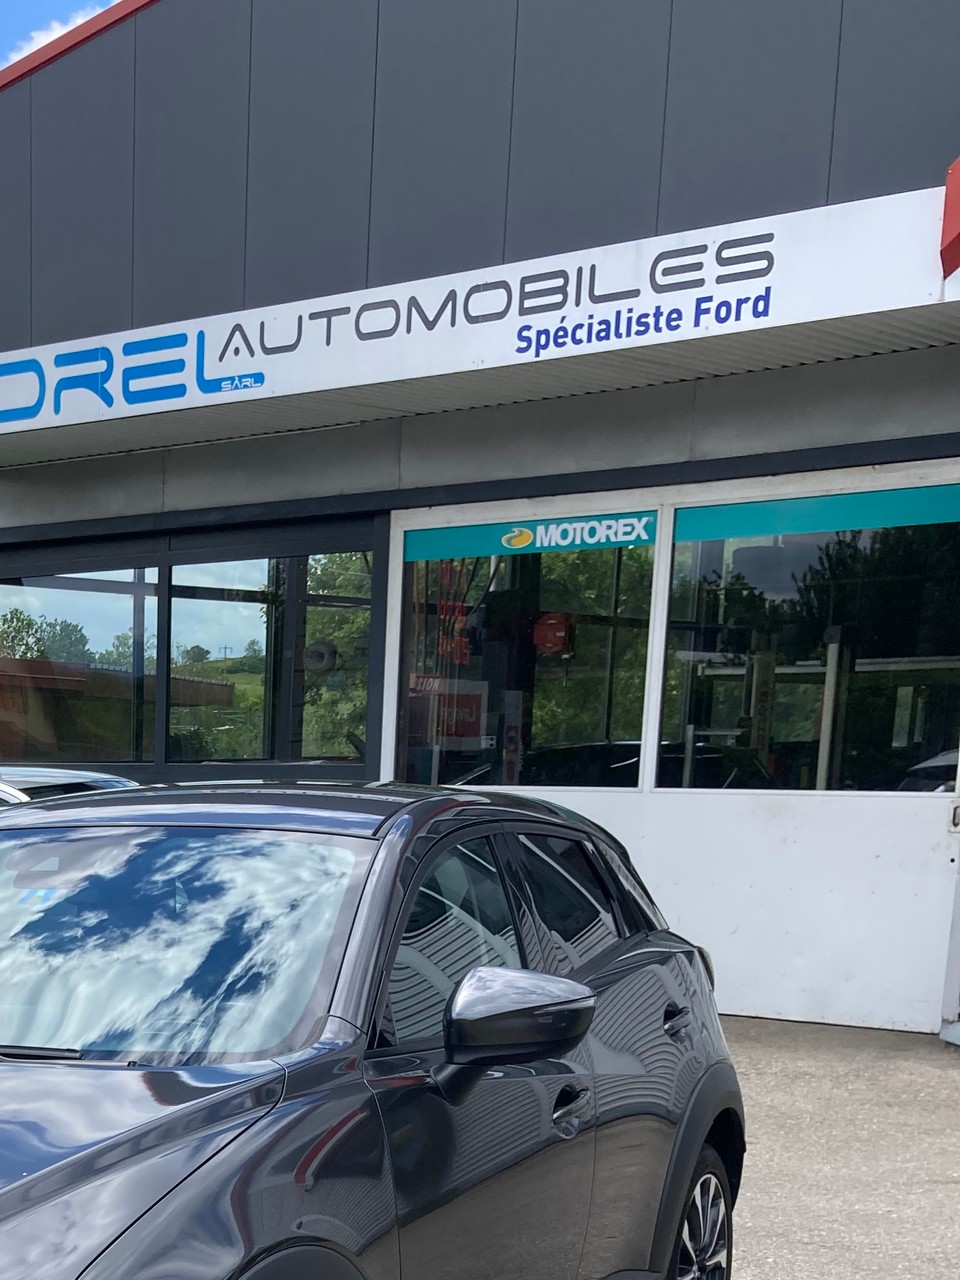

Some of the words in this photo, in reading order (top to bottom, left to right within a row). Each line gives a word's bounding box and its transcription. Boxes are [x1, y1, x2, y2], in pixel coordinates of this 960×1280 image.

[218, 232, 775, 363] AUTOMOBILES
[515, 305, 684, 358] Spécialiste
[694, 286, 772, 328] Ford
[535, 517, 650, 548] MOTOREX
